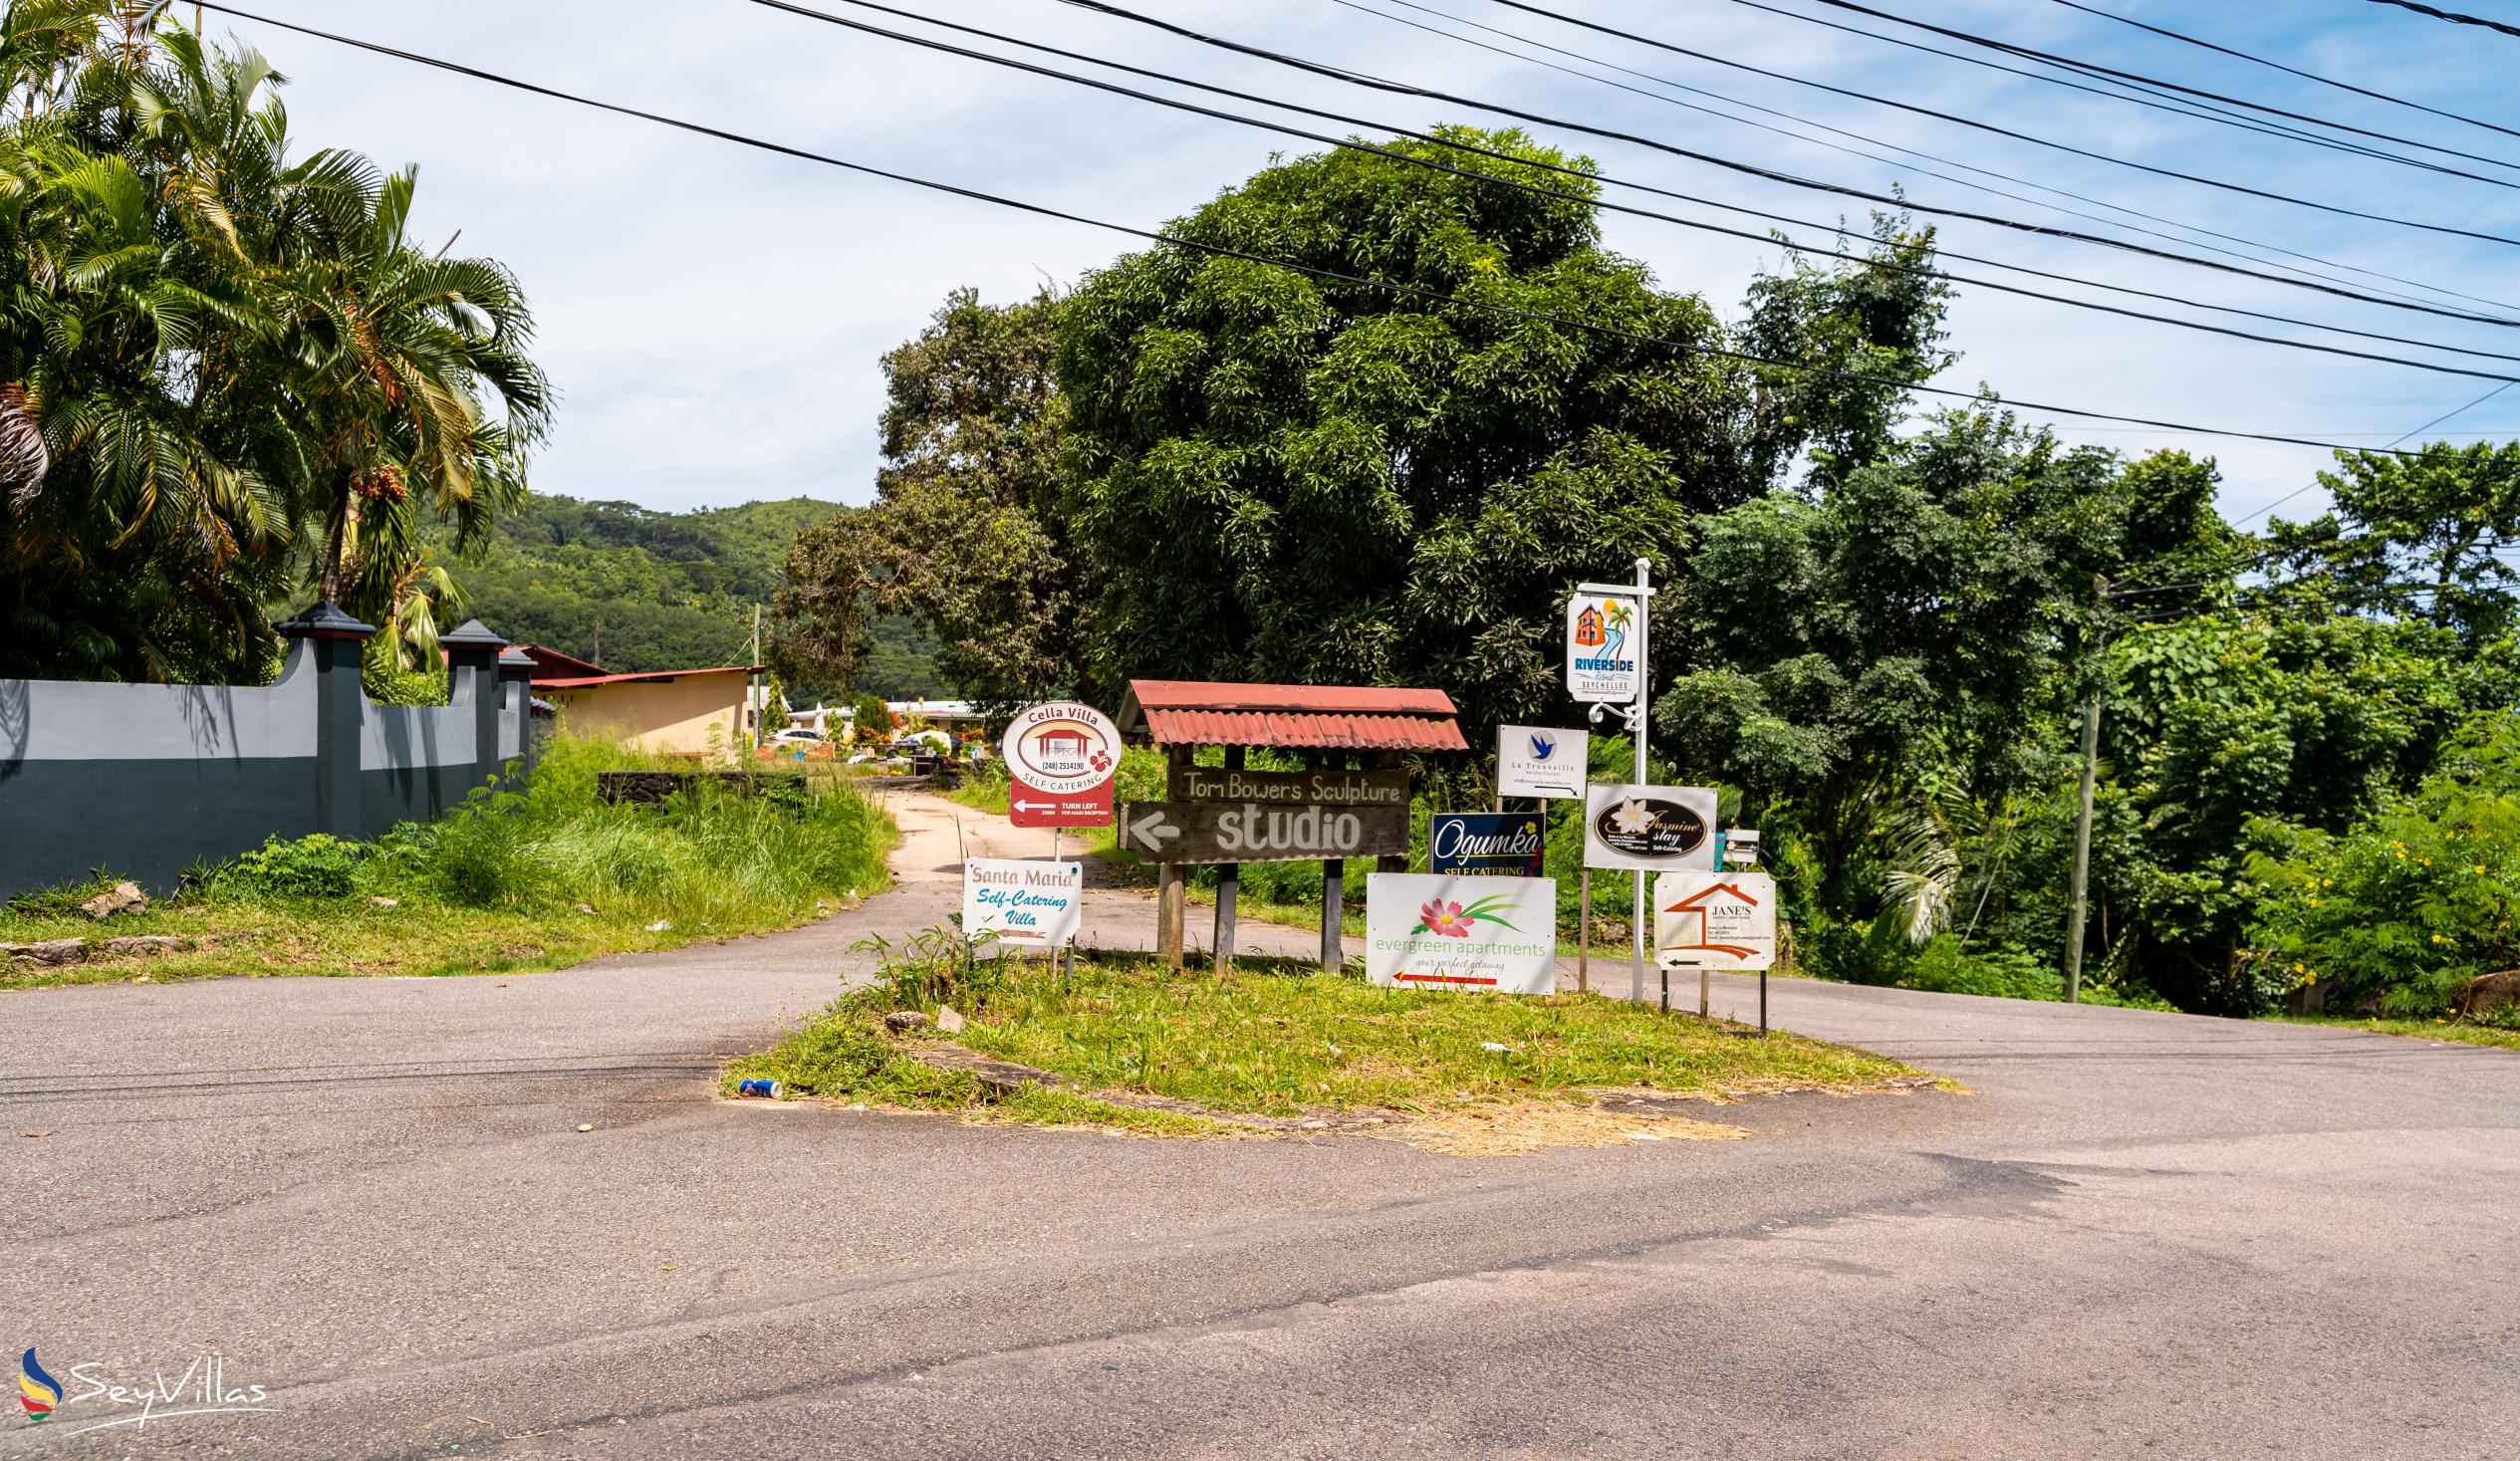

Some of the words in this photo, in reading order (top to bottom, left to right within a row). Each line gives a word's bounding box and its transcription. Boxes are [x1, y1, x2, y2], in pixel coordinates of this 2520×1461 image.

[1575, 658, 1634, 672] RIVERSIDE
[1028, 707, 1063, 723] Cella
[1068, 708, 1098, 726] Villa
[1042, 762, 1058, 771] (248)
[1526, 763, 1574, 771] Trouvaille
[1023, 773, 1046, 788] SELF
[1051, 774, 1102, 791] CATERING
[1183, 772, 1224, 798] Tom
[1229, 773, 1302, 800] Bowers
[1311, 776, 1400, 805] Sculpture
[1216, 804, 1361, 851] studio
[1641, 809, 1700, 836] Jasmine
[1434, 819, 1541, 866] Ogumka
[1652, 829, 1681, 848] stay
[972, 866, 1018, 885] Santa
[1025, 869, 1073, 887] Maria
[1444, 867, 1469, 876] SELF
[1471, 866, 1524, 876] CATERING
[976, 888, 1068, 912] Self-Catering
[1005, 910, 1037, 926] Villa
[1712, 906, 1751, 916] JANE'S
[1376, 939, 1451, 955] evergreen
[1456, 941, 1546, 957] apartments
[1411, 959, 1434, 972] your
[1437, 957, 1468, 973] perfect
[1466, 960, 1505, 975] getaway
